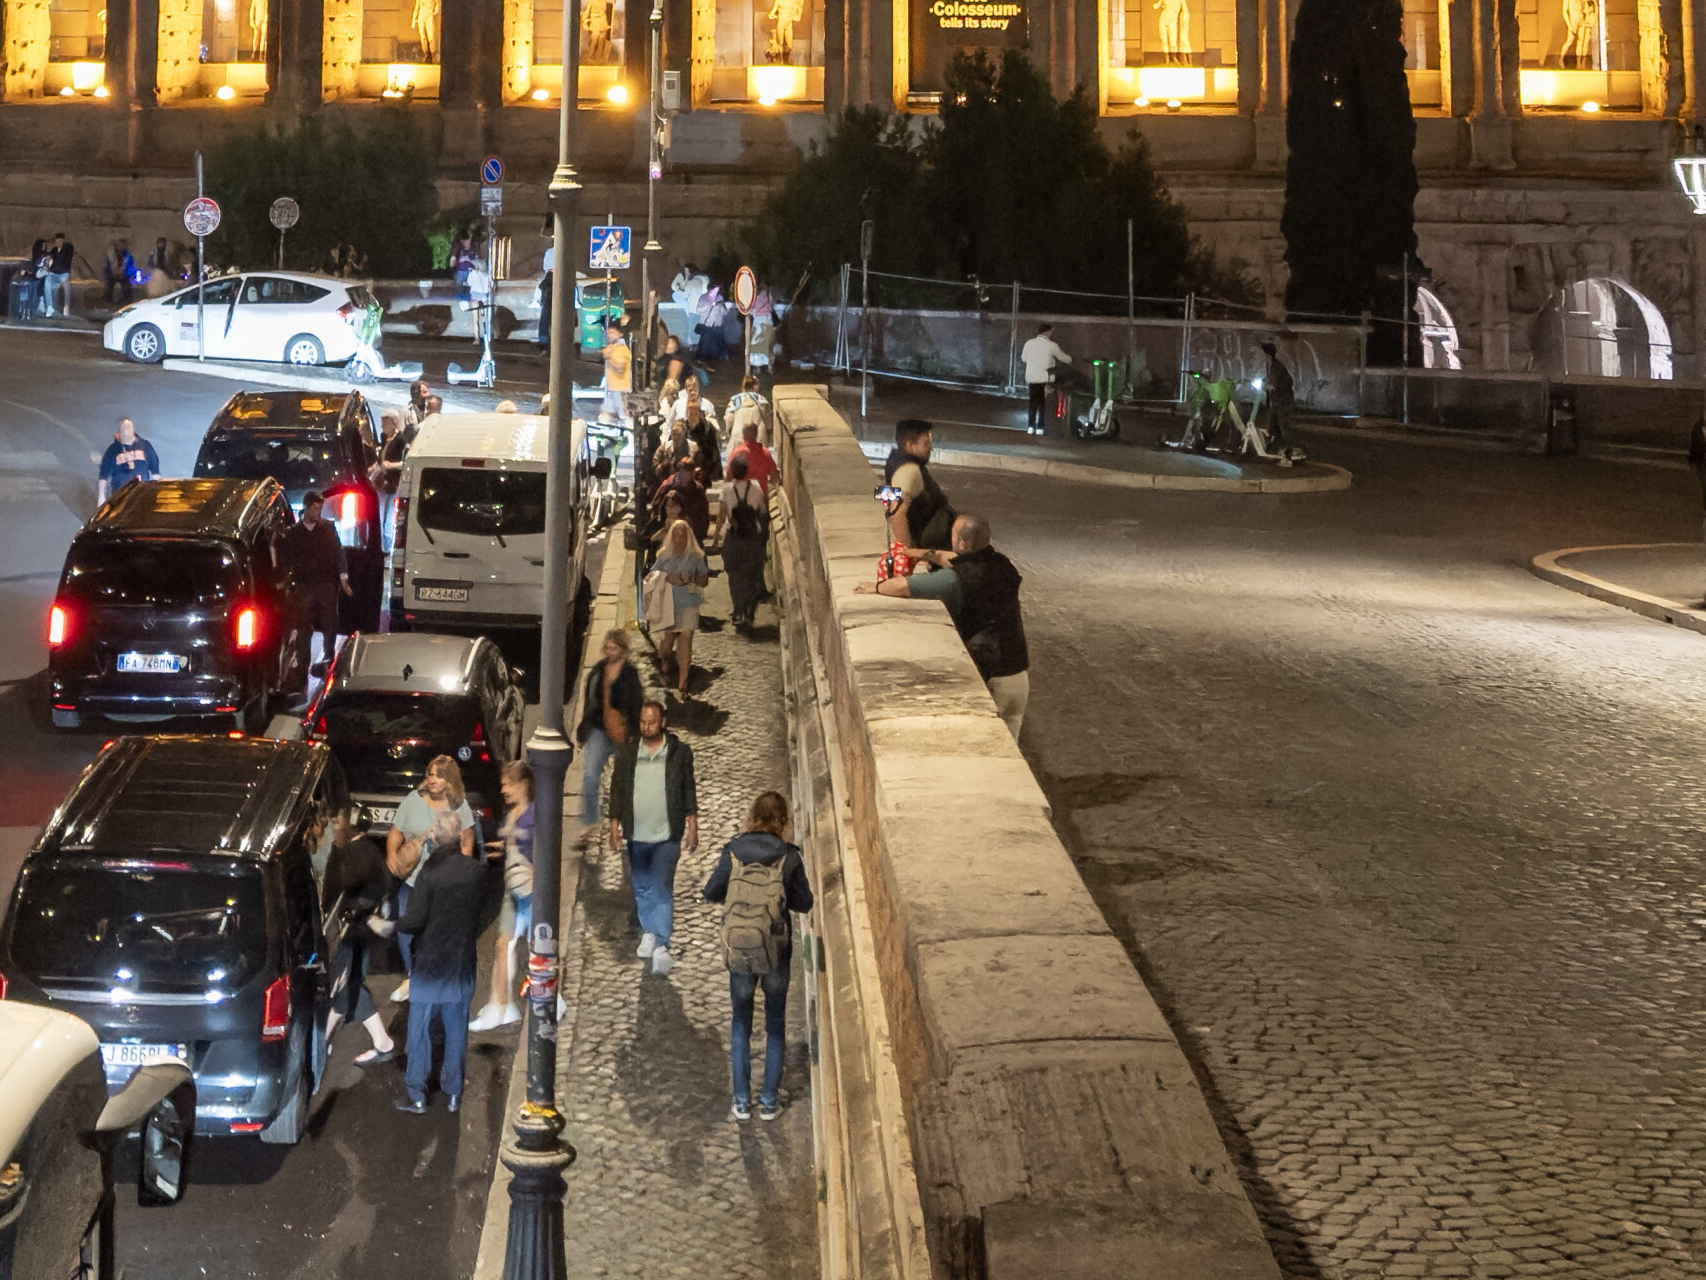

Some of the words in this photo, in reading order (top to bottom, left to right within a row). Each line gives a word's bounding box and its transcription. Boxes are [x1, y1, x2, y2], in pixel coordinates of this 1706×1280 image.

[933, 0, 1019, 17] Colosseum
[939, 17, 964, 28] tells
[964, 17, 980, 28] its
[980, 17, 1010, 30] story
